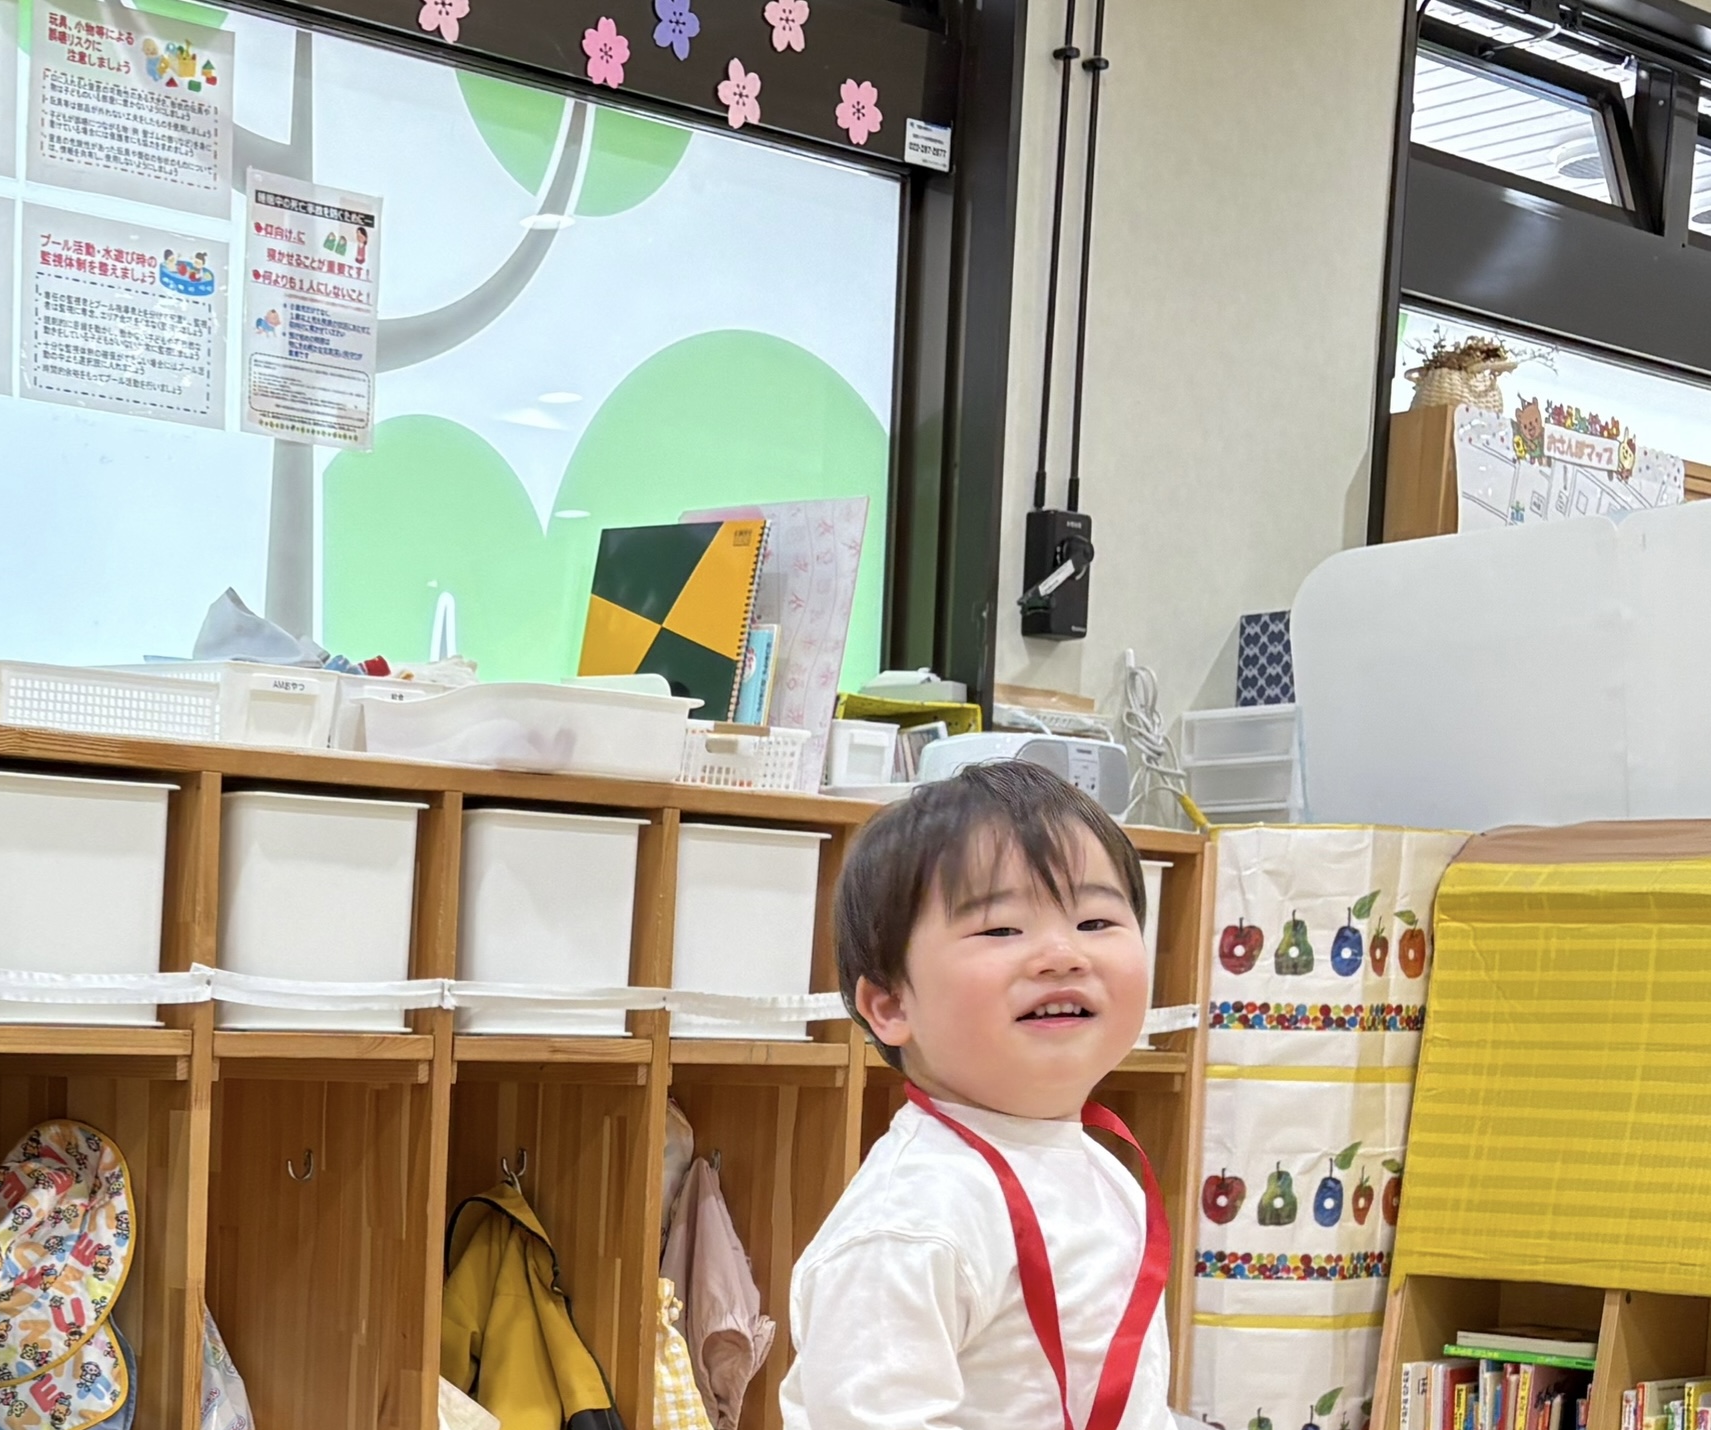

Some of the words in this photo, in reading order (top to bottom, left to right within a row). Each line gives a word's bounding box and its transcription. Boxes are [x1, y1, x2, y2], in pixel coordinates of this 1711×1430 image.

[48, 12, 135, 46] 玩具、小物等による
[67, 49, 131, 75] 注意しましょう
[40, 233, 158, 269] プール活動・水遊び時の
[40, 250, 157, 286] 監視体制を整えましょう
